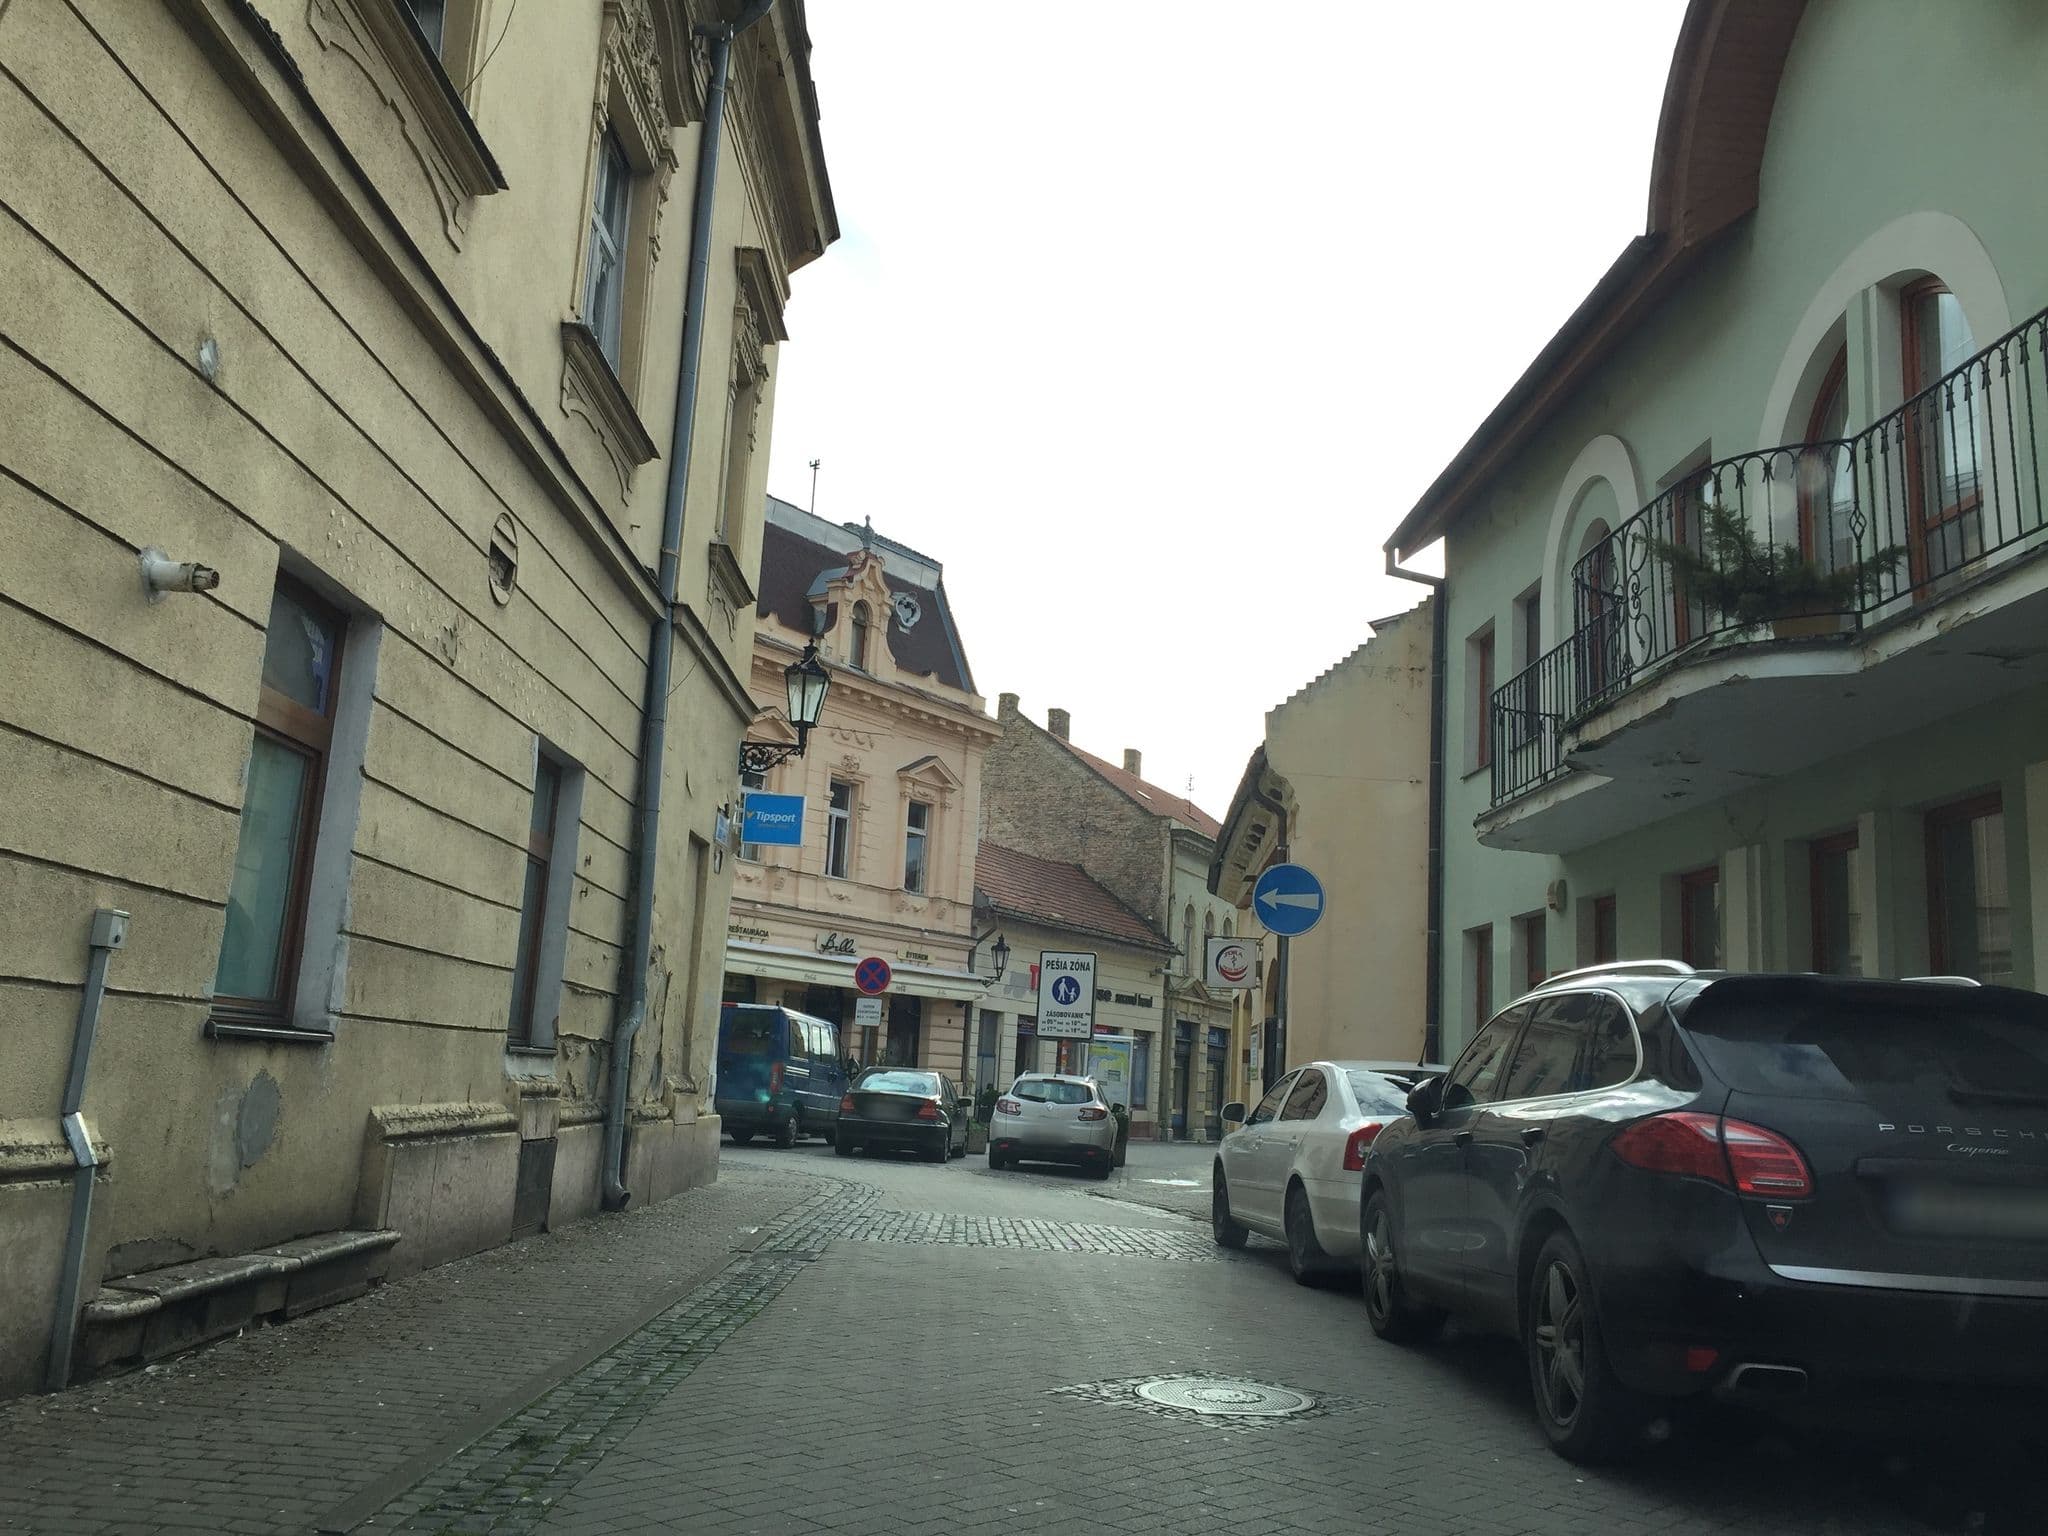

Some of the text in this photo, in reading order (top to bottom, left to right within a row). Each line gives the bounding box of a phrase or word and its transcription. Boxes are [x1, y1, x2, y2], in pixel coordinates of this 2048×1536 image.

[756, 811, 796, 823] Tipsport
[1045, 958, 1091, 971] PEŠIA ZÓNA
[1046, 1010, 1084, 1019] ZÁSOBOVANIE
[1878, 1123, 2048, 1140] PORSCH
[1947, 1143, 2009, 1157] Cayenne
